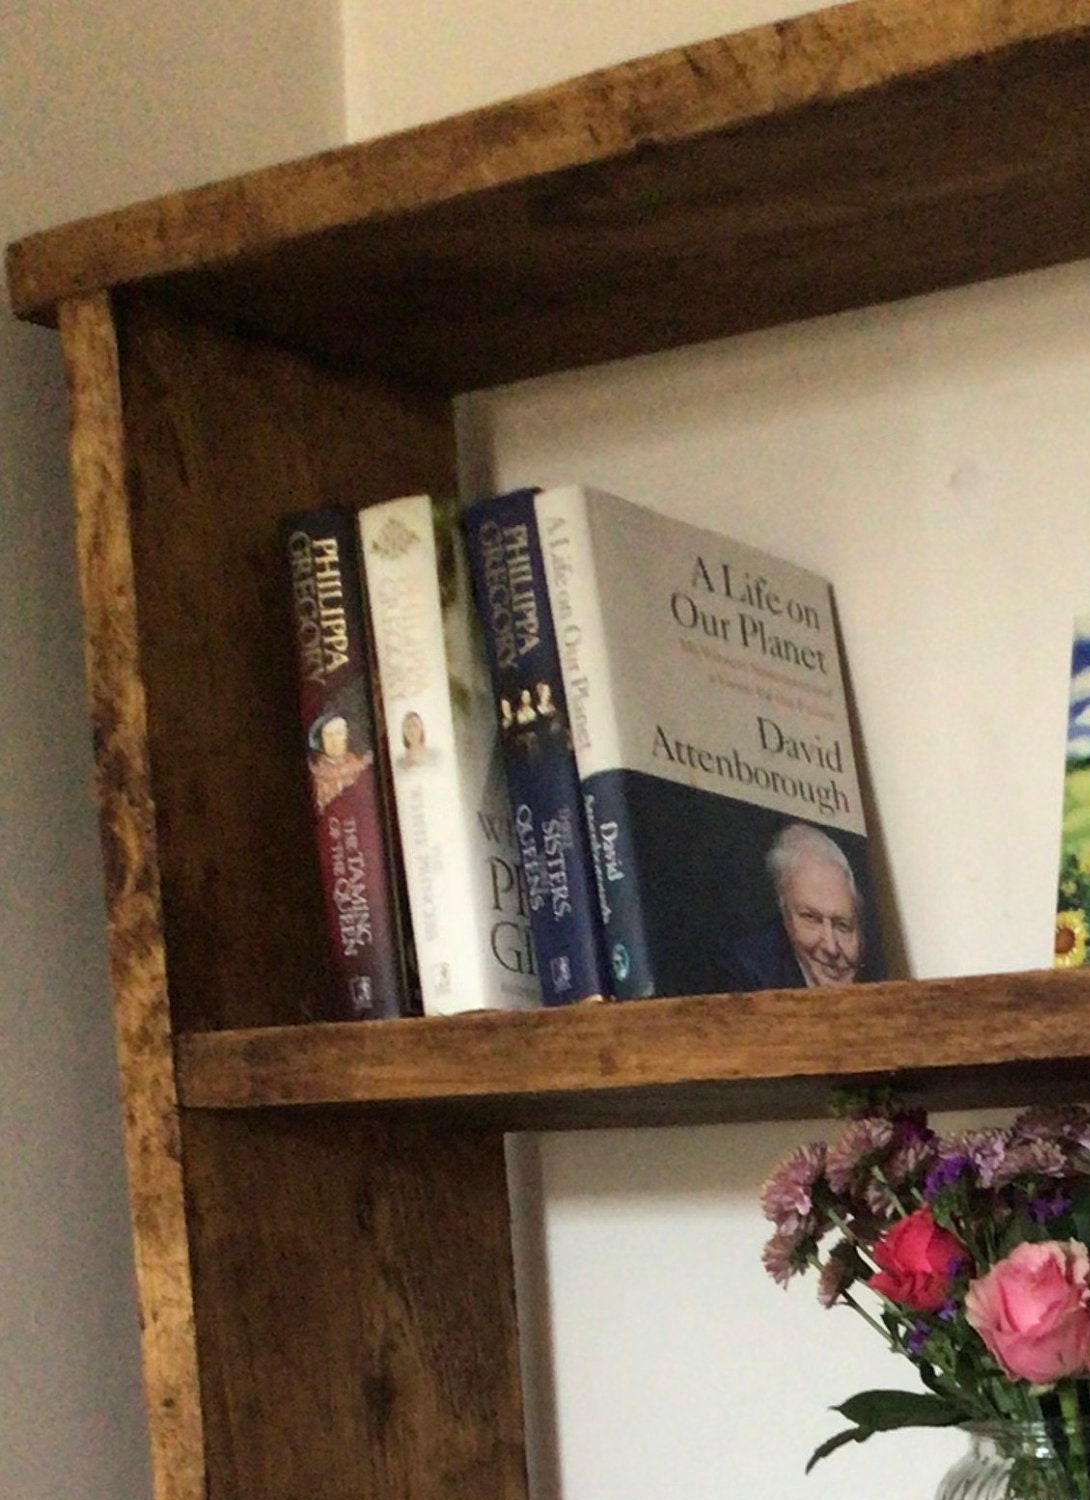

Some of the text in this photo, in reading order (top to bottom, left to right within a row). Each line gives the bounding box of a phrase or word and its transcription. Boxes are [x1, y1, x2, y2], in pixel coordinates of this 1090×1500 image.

[289, 530, 326, 686] GREGORY
[312, 538, 349, 675] PHILIPPA
[503, 524, 541, 656] PHILIPPA
[547, 516, 592, 749] A Life on Our Planet
[670, 592, 731, 641] Our
[738, 613, 829, 676] Planet
[691, 555, 822, 631] A Life on
[652, 724, 851, 816] Attenborough
[757, 715, 845, 774] David
[516, 804, 545, 912] QUEENS
[600, 820, 625, 882] David
[332, 877, 359, 957] QUEEN
[347, 852, 373, 946] TAMING
